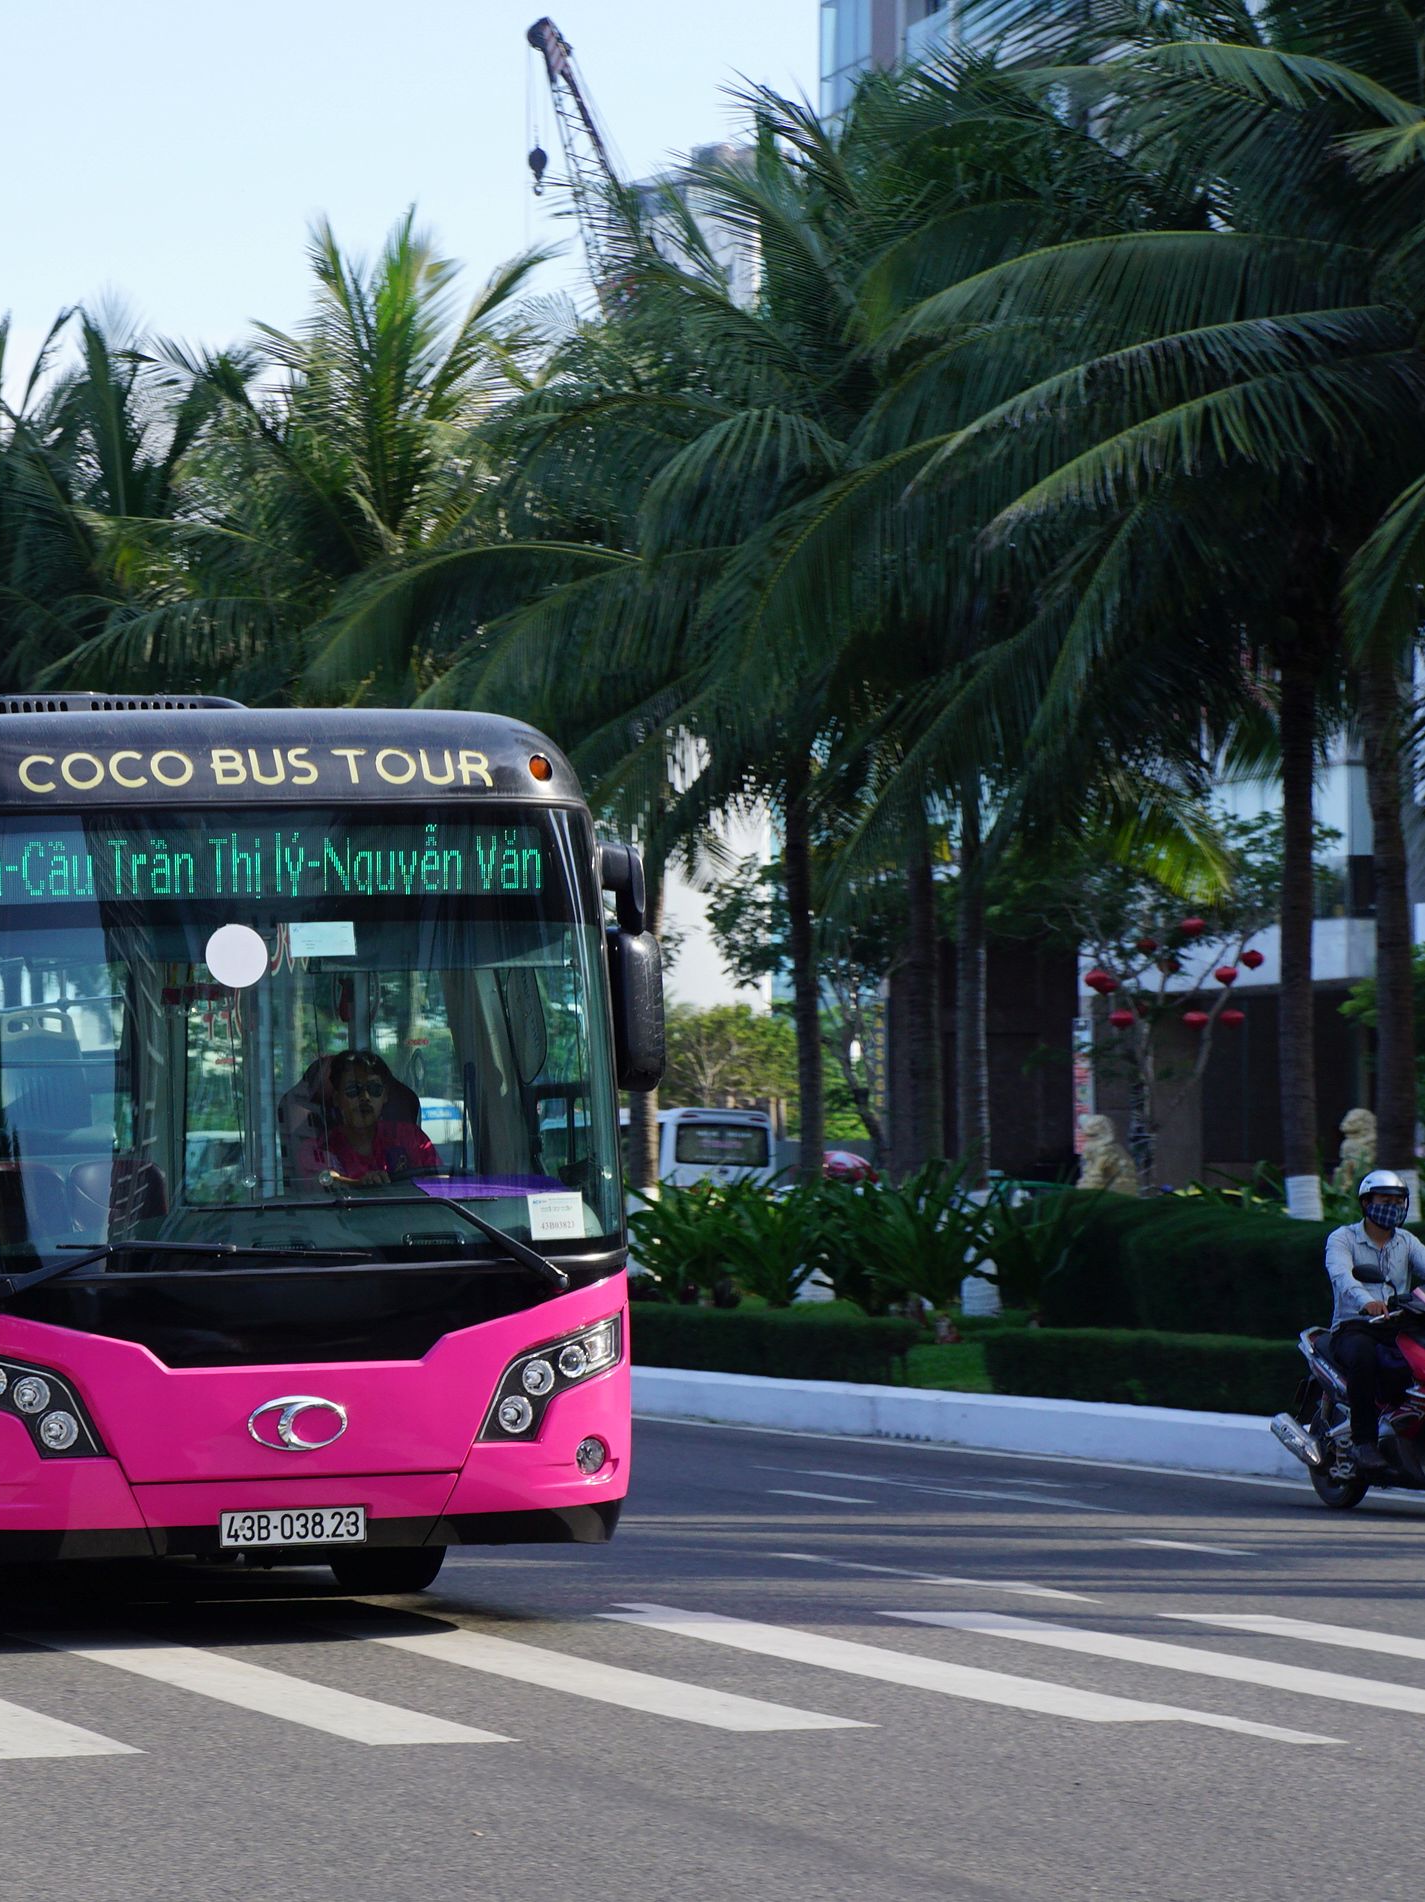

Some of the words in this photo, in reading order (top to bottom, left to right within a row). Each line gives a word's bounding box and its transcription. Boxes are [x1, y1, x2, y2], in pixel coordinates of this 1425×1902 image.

[18, 749, 194, 793] COCO
[210, 747, 318, 786] BUS
[331, 747, 494, 788] TOUR
[107, 839, 194, 895] Trần
[208, 833, 261, 899] Thị
[476, 829, 542, 891] Văn
[226, 1510, 360, 1542] 43B-038.23
